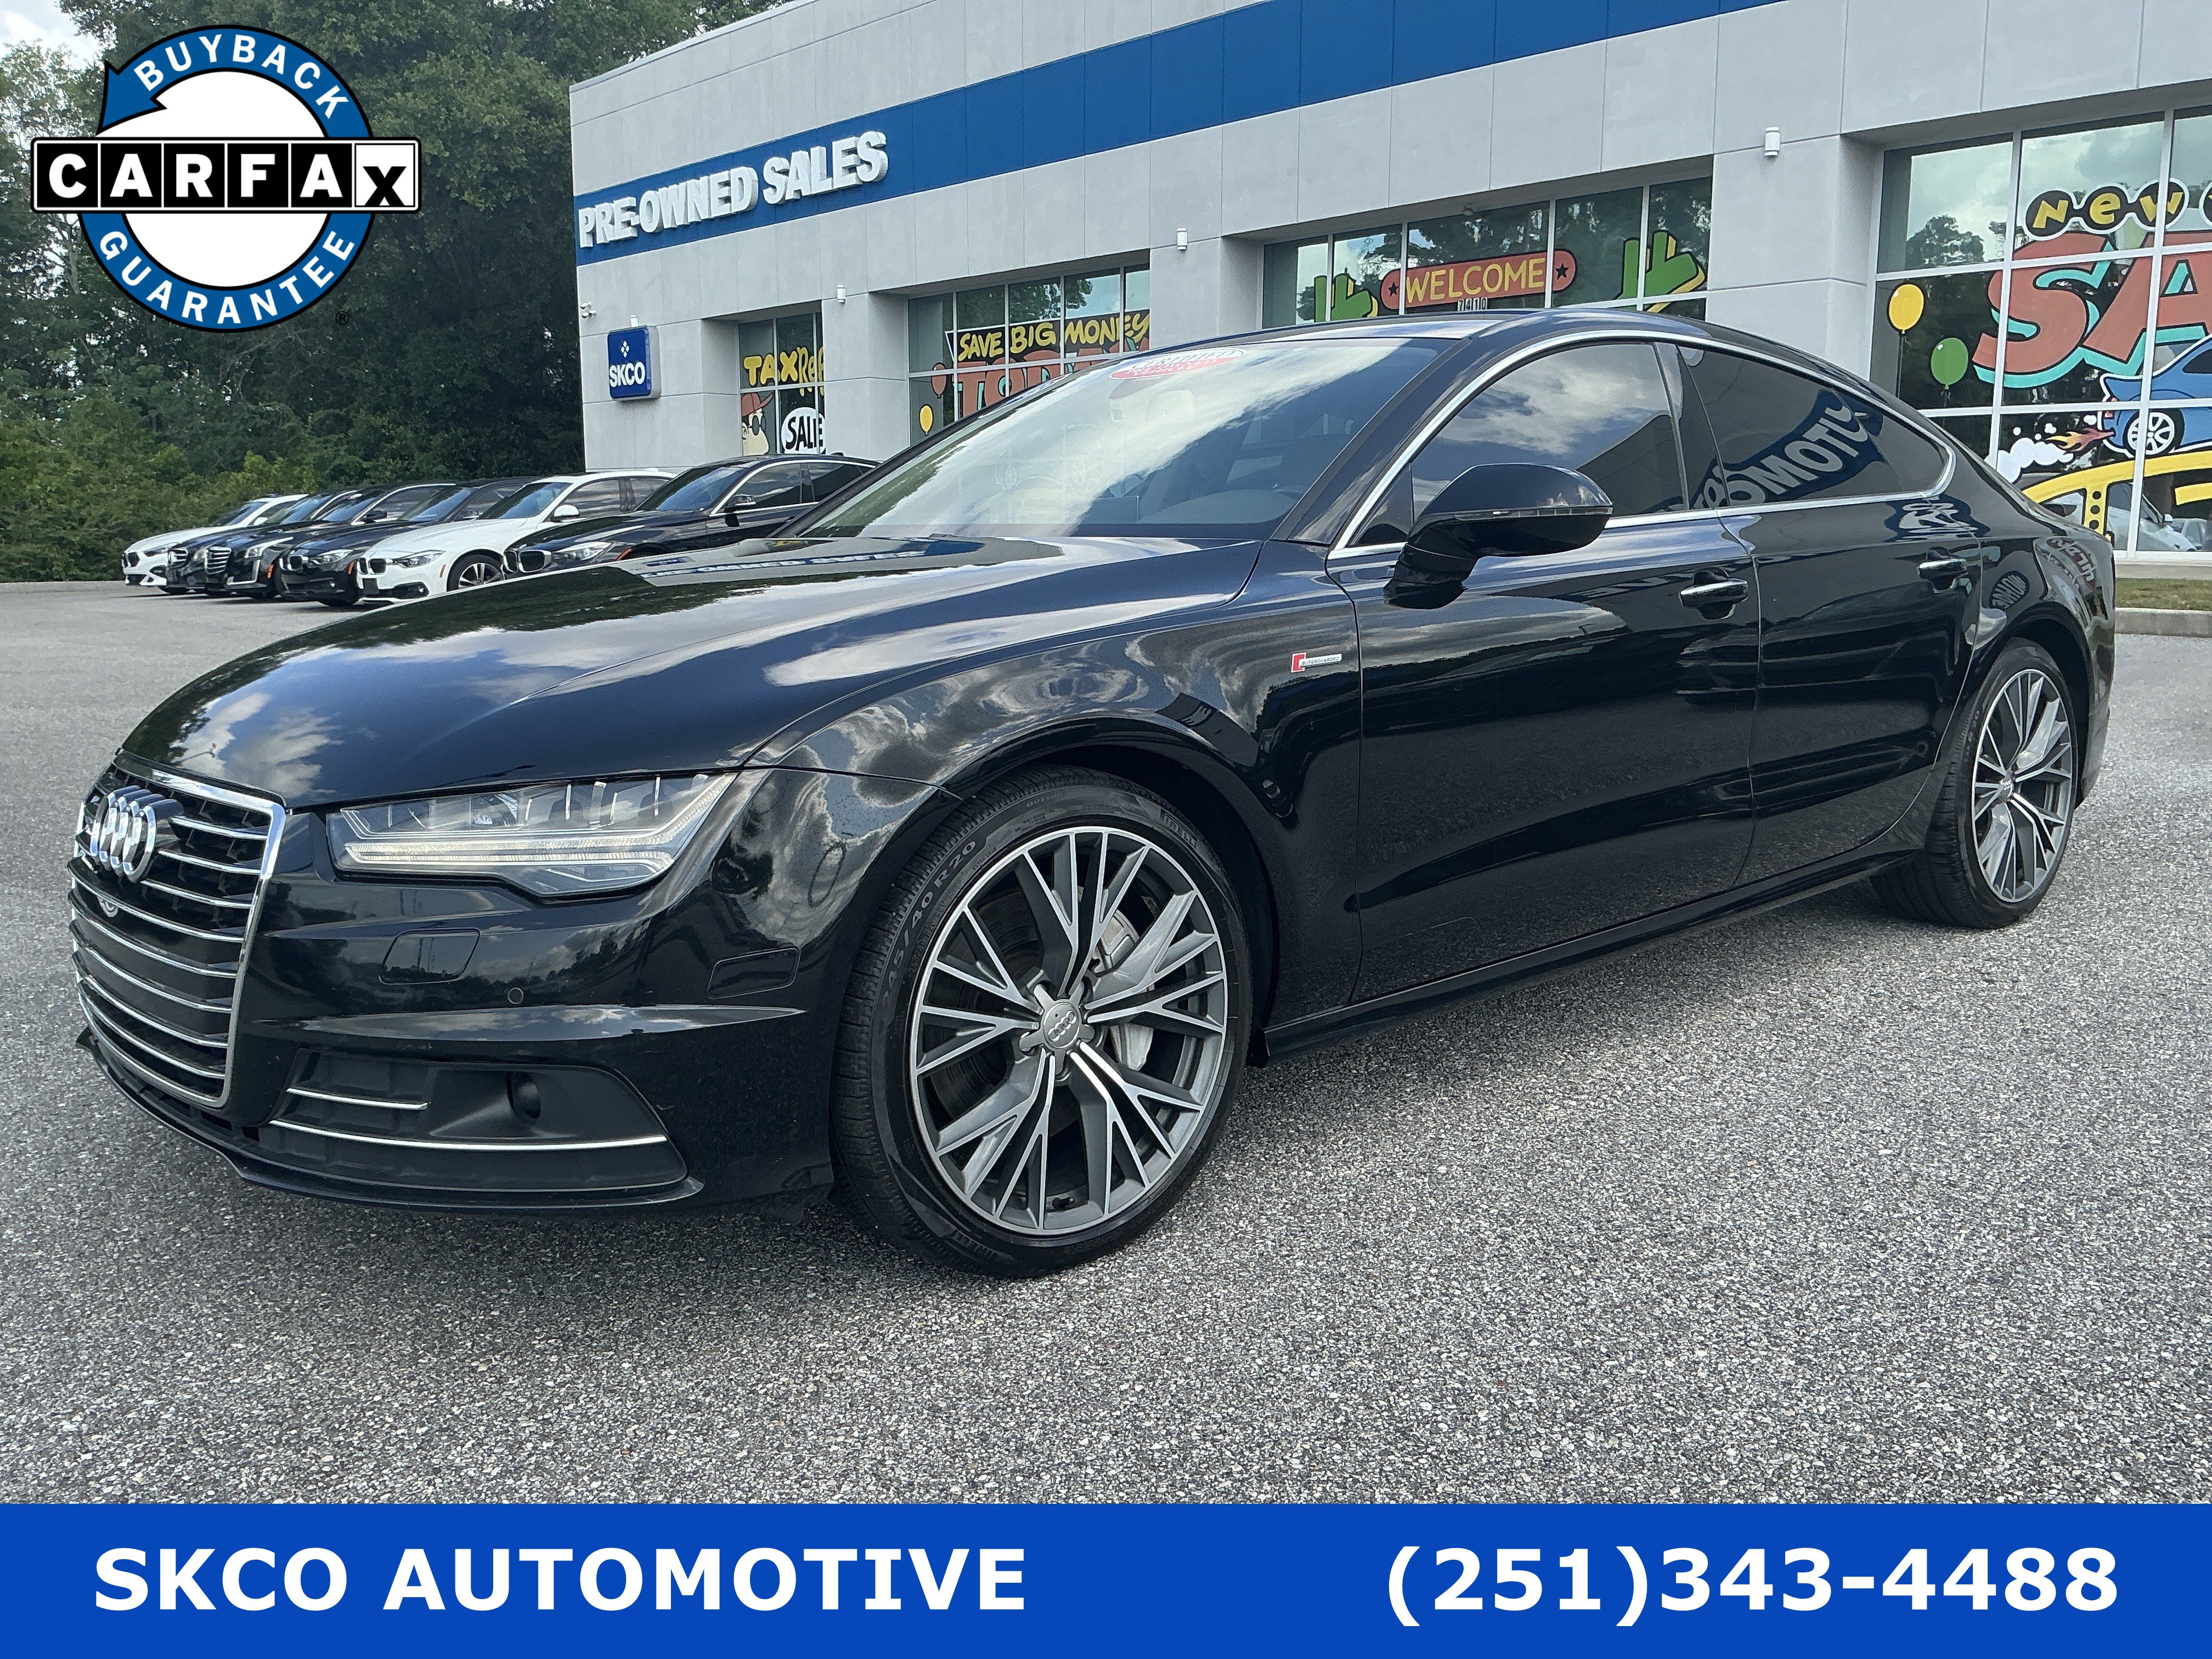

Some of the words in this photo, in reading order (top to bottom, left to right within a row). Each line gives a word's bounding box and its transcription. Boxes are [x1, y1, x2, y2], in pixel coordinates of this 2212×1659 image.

[579, 166, 758, 247] PRE-OWNED
[763, 131, 888, 204] SALES
[1406, 257, 1545, 304] WELCOME
[1458, 297, 1486, 312] 7410
[958, 331, 1005, 361] SAVE
[1010, 322, 1057, 354] BIG
[1064, 313, 1150, 343] MONEY
[609, 362, 646, 388] SKCO
[785, 415, 823, 452] SALE
[934, 840, 976, 889] R20
